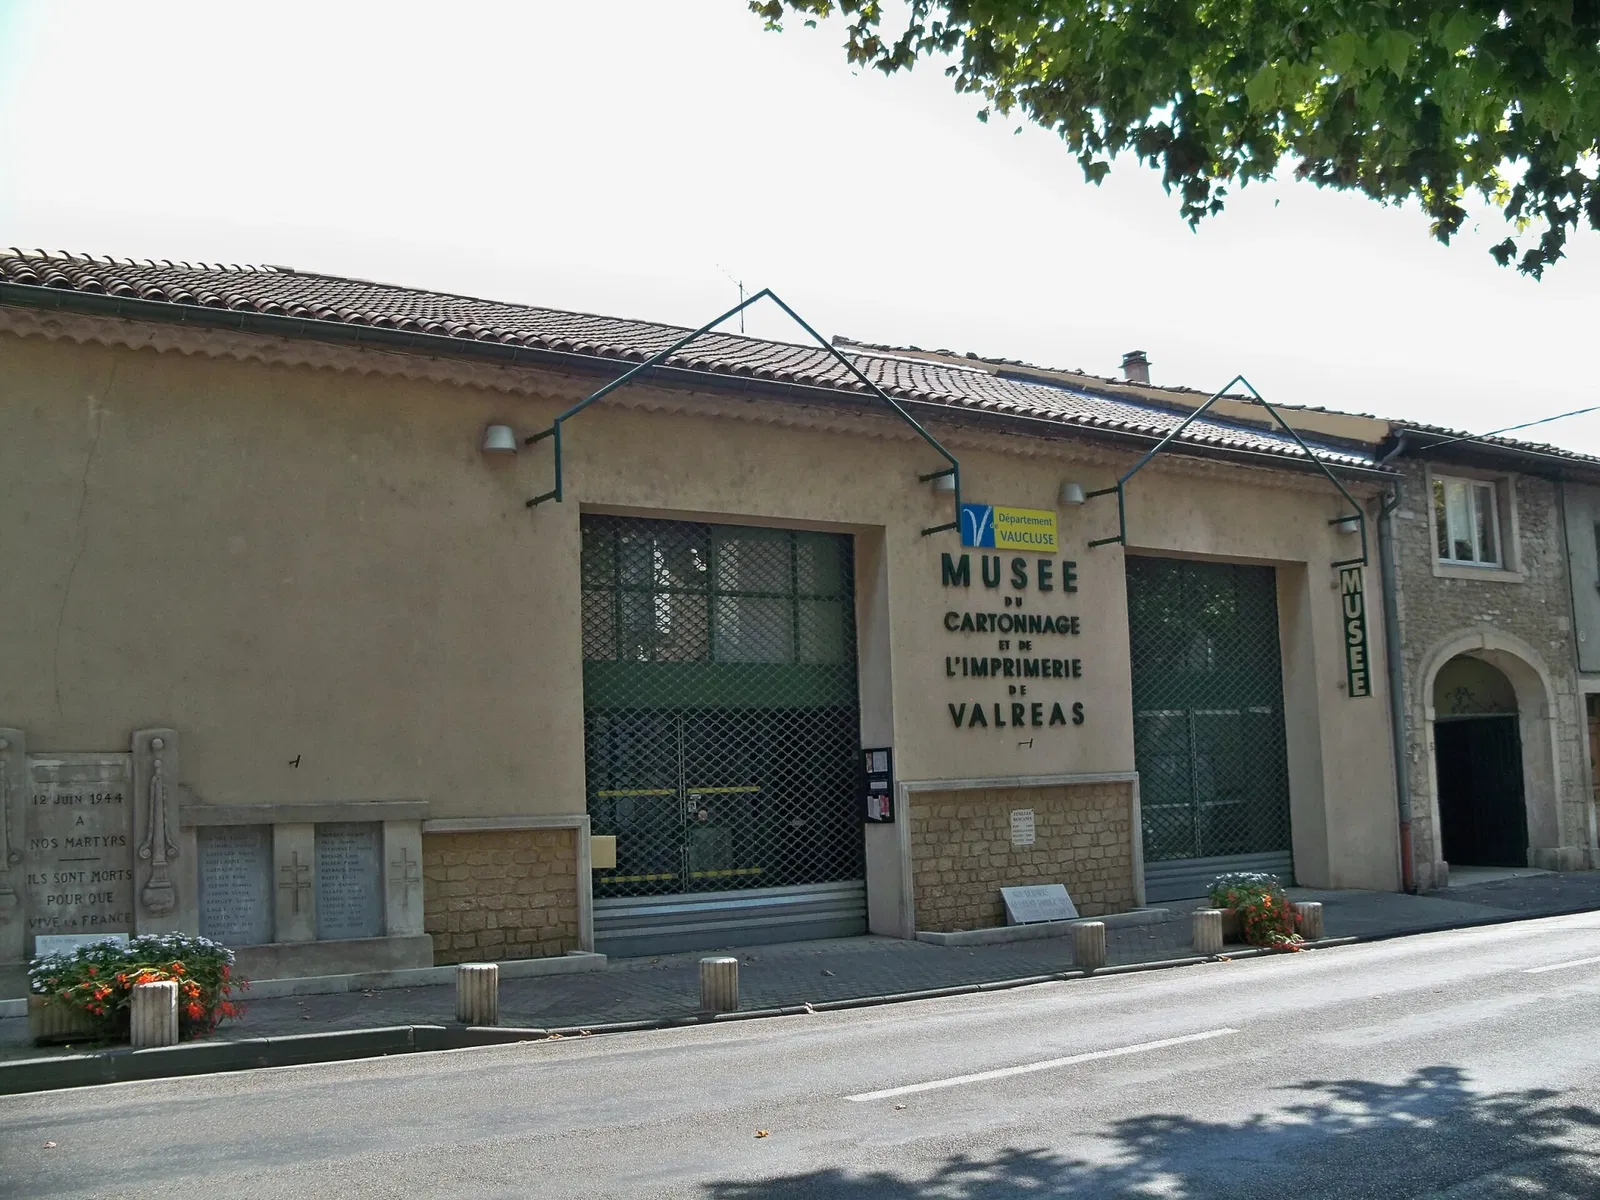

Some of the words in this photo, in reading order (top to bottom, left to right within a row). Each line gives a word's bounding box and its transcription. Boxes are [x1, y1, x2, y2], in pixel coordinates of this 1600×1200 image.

[999, 513, 1053, 527] Département
[1000, 531, 1054, 545] VAUCLUSE
[941, 553, 1078, 593] MUSEE
[1004, 596, 1023, 608] DU
[944, 611, 1081, 635] CARTONNAGE
[1342, 569, 1366, 697] MUSEE
[998, 640, 1011, 651] ET
[1018, 640, 1032, 651] DE
[946, 656, 1082, 678] L'IMPRIMERIE
[1008, 684, 1027, 695] DE
[948, 702, 1085, 728] VALREAS
[33, 795, 47, 805] 12
[54, 794, 82, 805] JUIN
[91, 793, 123, 804] 1944
[75, 816, 85, 826] A
[30, 838, 58, 849] NOS
[64, 835, 127, 849] MARTYRS
[28, 873, 47, 885] ILS
[54, 871, 85, 884] SONT
[92, 869, 133, 882] MORTS
[47, 894, 82, 906] POUR
[89, 892, 114, 905] QUE
[28, 916, 60, 928] VIVE
[64, 919, 77, 927] LA
[82, 913, 133, 926] FRANCE
